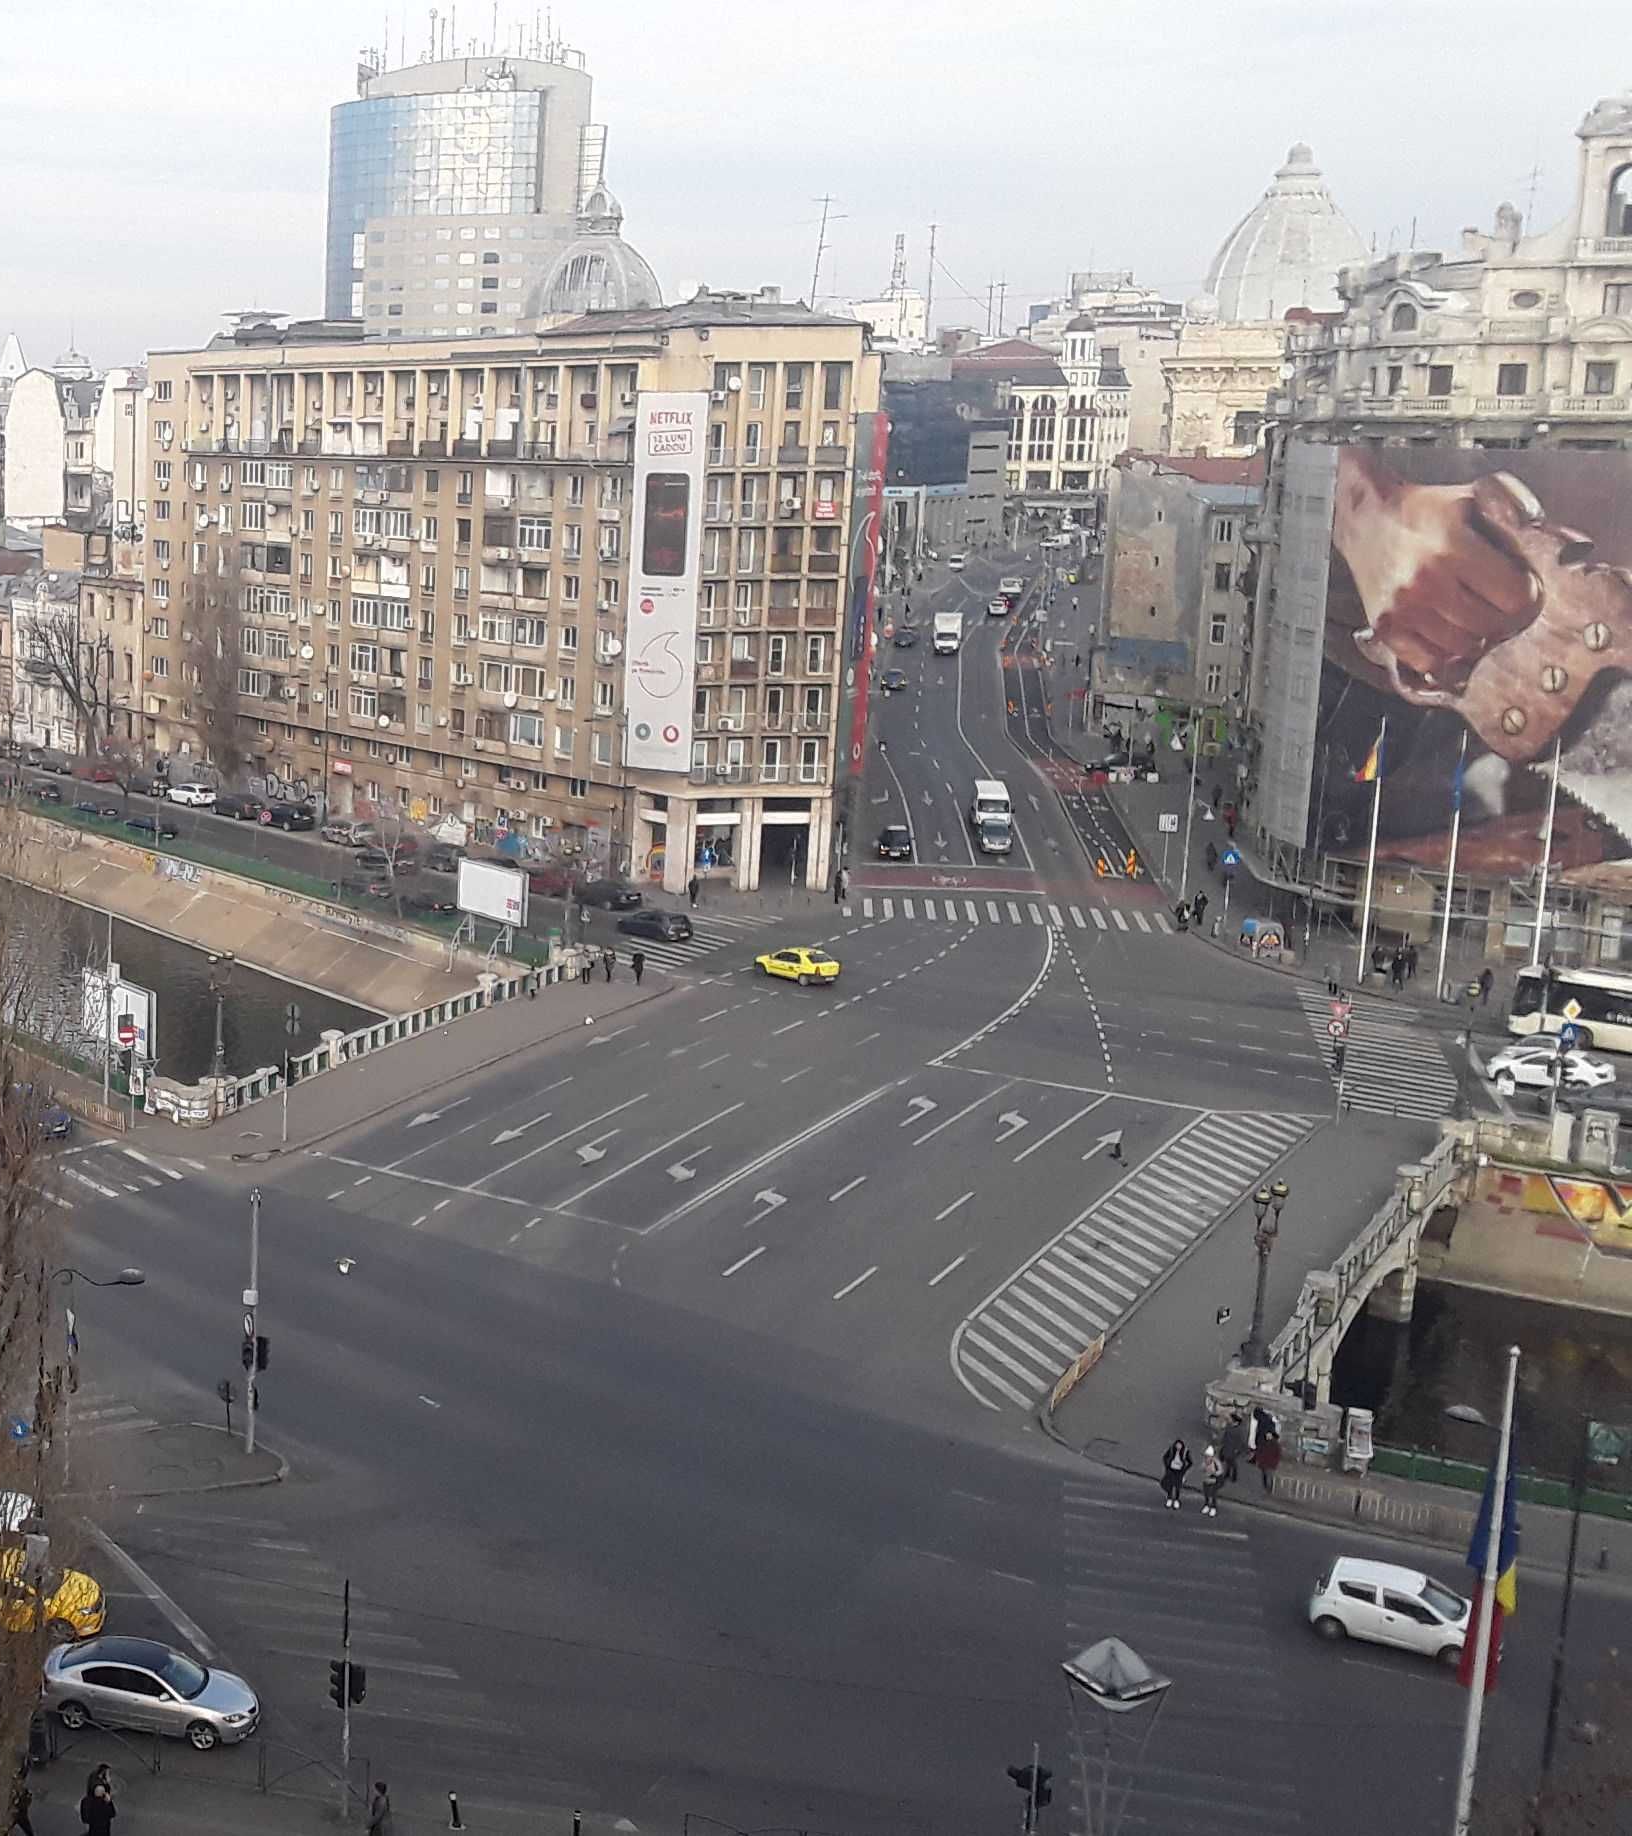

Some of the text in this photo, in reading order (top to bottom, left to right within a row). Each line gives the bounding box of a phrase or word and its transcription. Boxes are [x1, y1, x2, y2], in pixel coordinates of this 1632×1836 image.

[649, 411, 693, 425] NETFLIX
[665, 433, 687, 442] LUNI
[654, 443, 686, 452] CADOU
